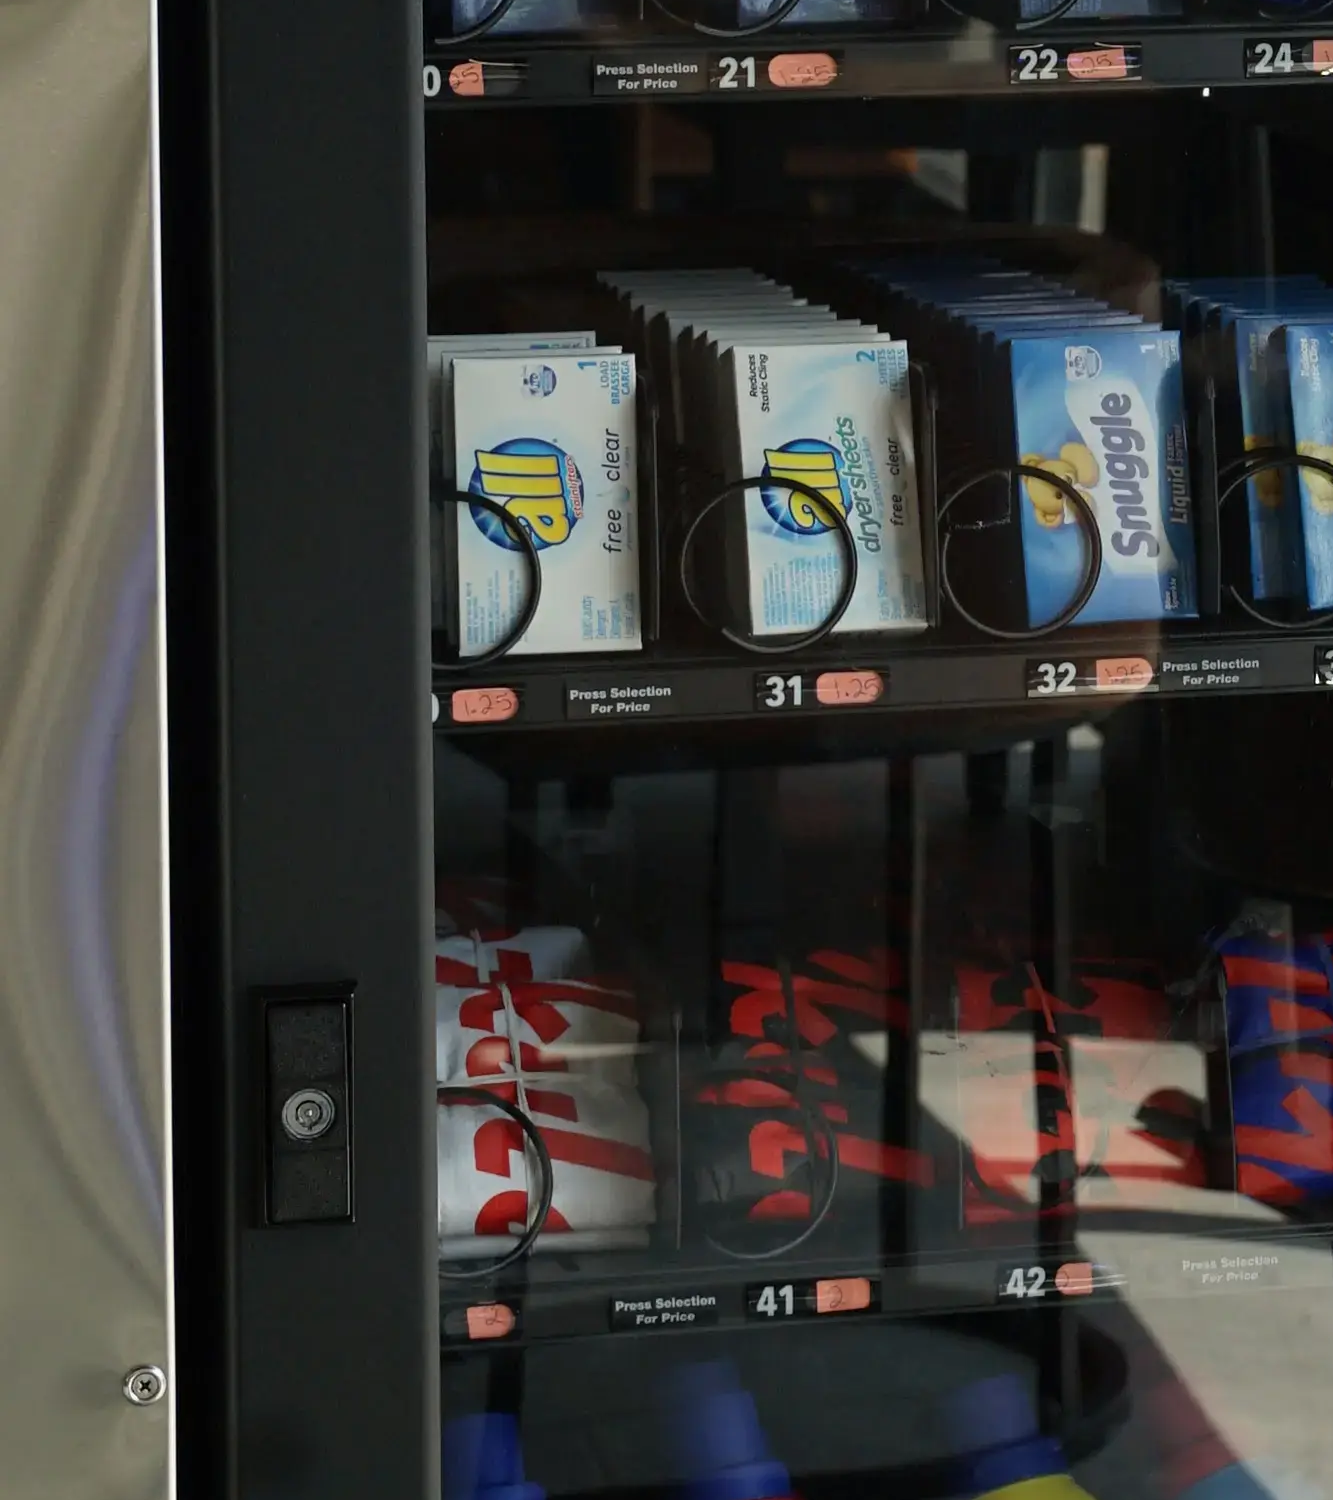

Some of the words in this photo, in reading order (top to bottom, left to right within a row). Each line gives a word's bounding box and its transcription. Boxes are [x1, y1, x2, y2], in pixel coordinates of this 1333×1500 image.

[596, 63, 633, 75] Press
[638, 62, 698, 75] Selection
[719, 57, 755, 88] 21
[1019, 49, 1059, 80] 22
[1254, 42, 1293, 73] 24
[618, 79, 640, 89] For
[643, 78, 678, 89] Price
[578, 361, 597, 370] 1
[759, 353, 768, 383] Cling
[856, 350, 875, 362] 2
[600, 360, 609, 388] LOAD
[611, 359, 620, 405] BRASSEE
[621, 359, 630, 396] CARGA
[749, 354, 758, 397] Reduces
[760, 385, 770, 412] Static
[601, 428, 621, 481] clear
[837, 416, 867, 492] sheets
[887, 437, 900, 476] clear
[764, 449, 848, 529] all
[1090, 391, 1160, 558] Snuggle
[474, 449, 571, 544] all
[1169, 465, 1188, 524] Liquid
[853, 490, 882, 553] dryer
[890, 494, 905, 527] free
[602, 509, 622, 553] free
[1037, 663, 1076, 694] 32
[1163, 661, 1197, 672] Press
[1201, 658, 1259, 670] Selection
[1183, 675, 1204, 685] For
[1208, 674, 1239, 685] Price
[570, 689, 605, 701] Press
[611, 685, 671, 699] Selection
[765, 676, 802, 707] 31
[834, 678, 882, 700] 1.25
[465, 694, 513, 716] 1.25
[591, 703, 613, 714] For
[616, 701, 650, 713] Price
[1182, 1259, 1217, 1272] Press
[1220, 1255, 1279, 1269] Selection
[1202, 1273, 1223, 1284] For
[1226, 1271, 1259, 1283] Price
[1006, 1267, 1046, 1298] 42
[615, 1299, 652, 1312] Press
[656, 1295, 716, 1309] Selection
[756, 1285, 795, 1316] 41
[636, 1314, 658, 1325] For
[662, 1311, 695, 1323] Price
